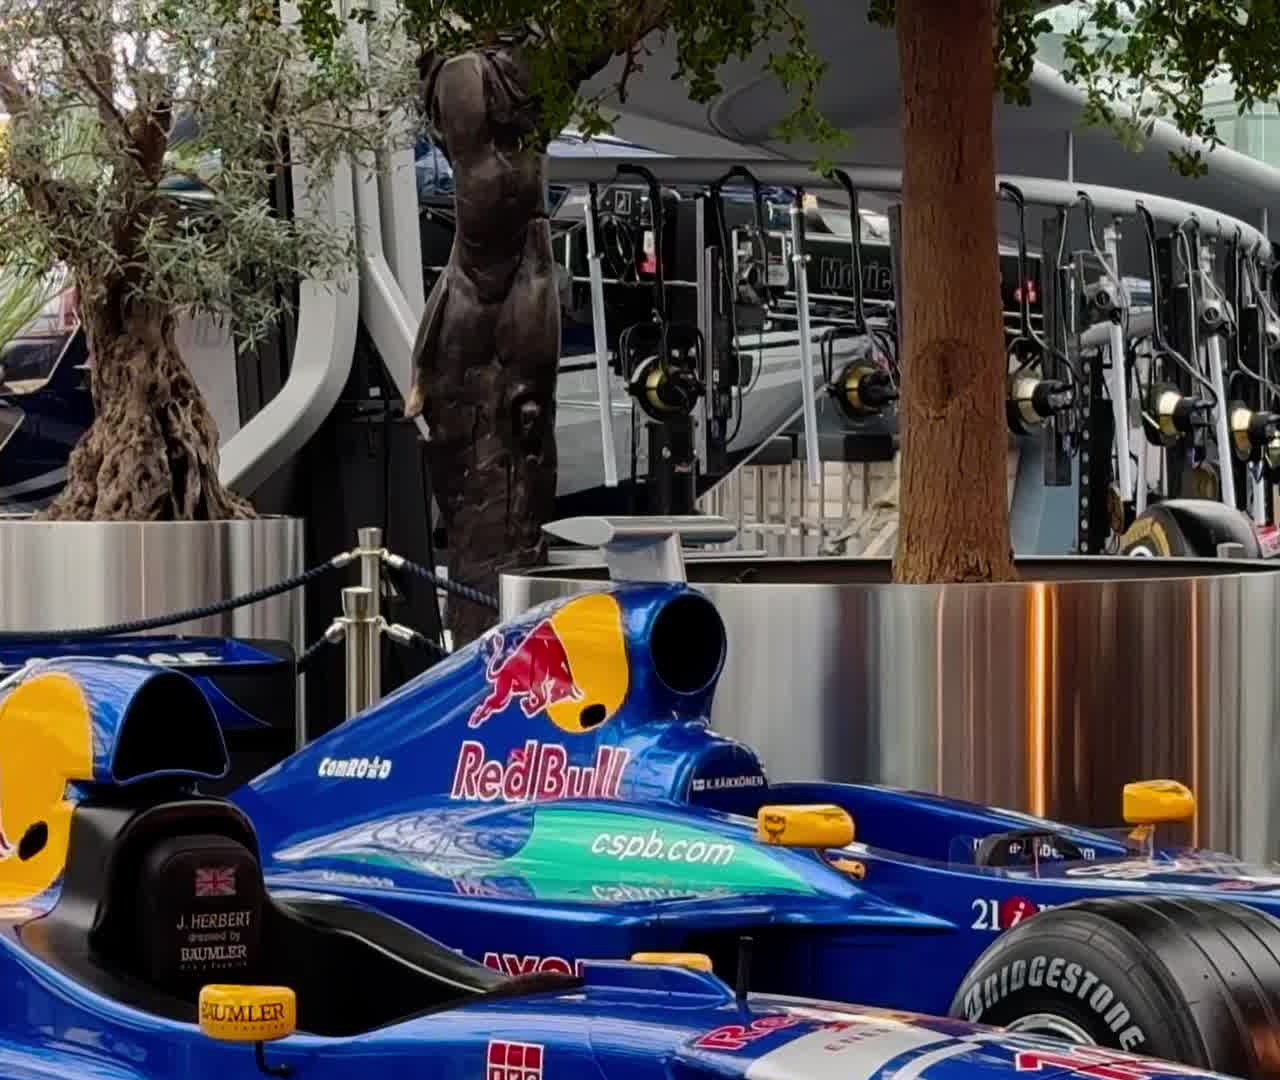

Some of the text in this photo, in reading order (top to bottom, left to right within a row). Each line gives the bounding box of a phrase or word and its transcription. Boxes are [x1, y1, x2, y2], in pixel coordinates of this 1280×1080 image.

[450, 740, 631, 801] Red Bull
[591, 829, 735, 866] cspb.com
[191, 911, 252, 928] HERBERT
